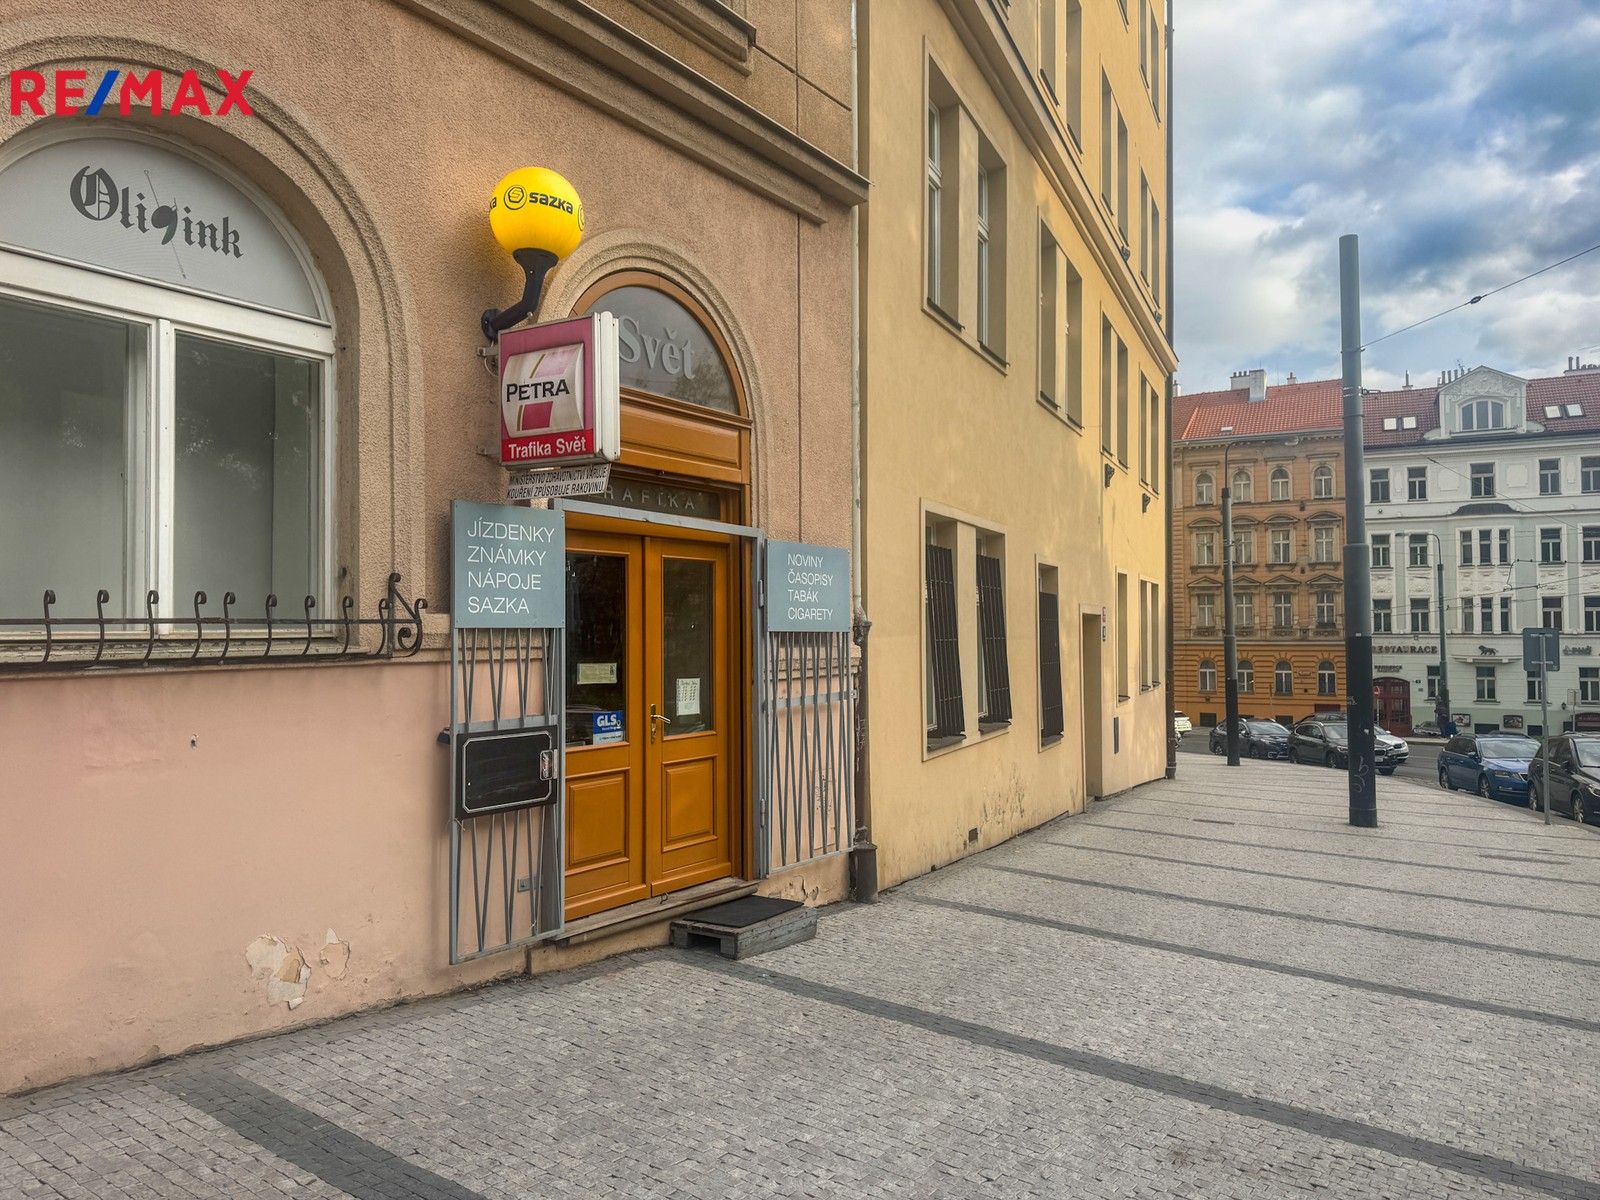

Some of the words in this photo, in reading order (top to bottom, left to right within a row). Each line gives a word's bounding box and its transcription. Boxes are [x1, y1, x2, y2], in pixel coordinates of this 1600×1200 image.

[618, 315, 696, 380] Svět
[506, 379, 570, 402] PETRA
[508, 441, 552, 459] Trafika
[556, 435, 587, 454] Svět
[604, 485, 696, 510] RAFIKA
[467, 516, 555, 543] JÍZDENKY
[467, 543, 547, 566] ZNÁMKY
[787, 553, 824, 568] NOVINY
[468, 567, 542, 590] NÁPOJE
[787, 568, 834, 586] ČASOPISY
[467, 596, 530, 614] SAZKA
[787, 587, 819, 603] TABÁK
[787, 607, 834, 620] CIGARETY
[597, 714, 617, 727] GLS
